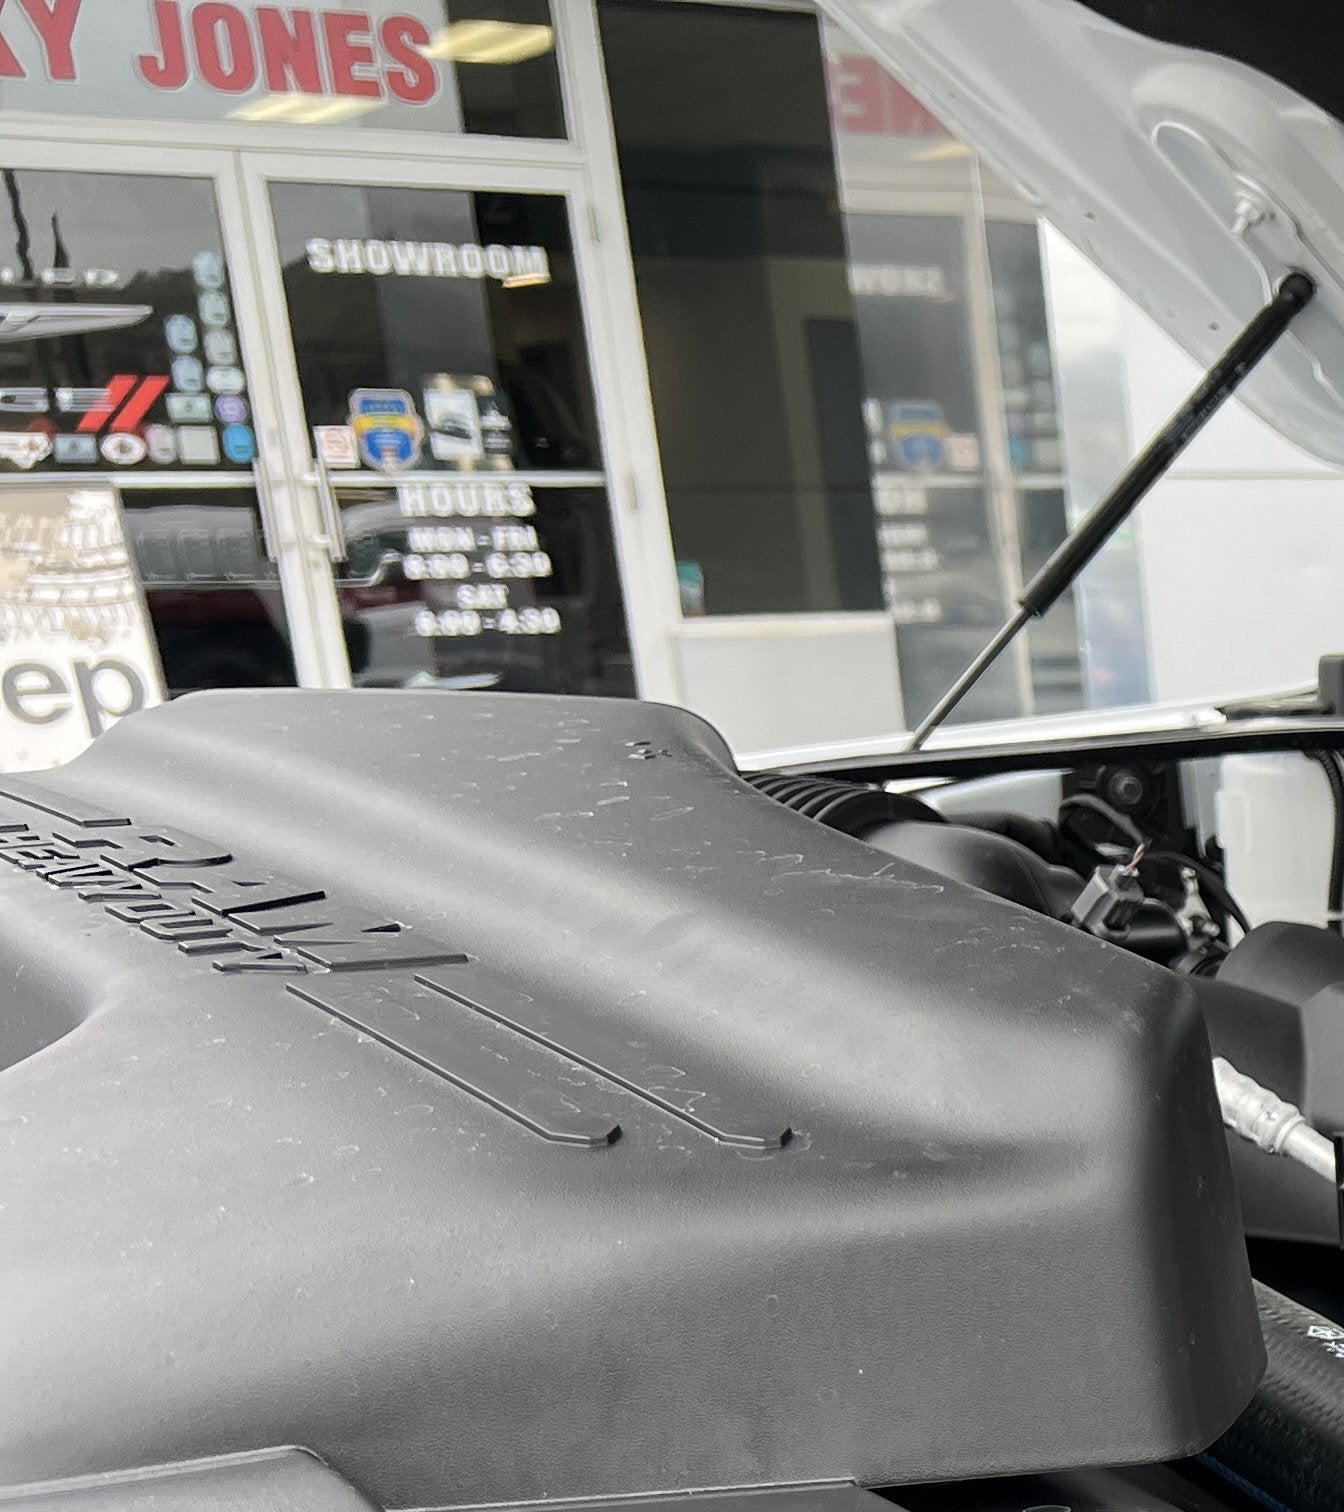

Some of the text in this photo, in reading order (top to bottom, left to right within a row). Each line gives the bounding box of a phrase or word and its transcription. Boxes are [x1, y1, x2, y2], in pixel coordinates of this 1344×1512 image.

[137, 0, 439, 105] JONES
[305, 238, 550, 281] SHOWROOM
[397, 483, 538, 517] HOURS
[407, 526, 477, 552] MON
[491, 525, 540, 551] FRI
[456, 583, 511, 610] SAT
